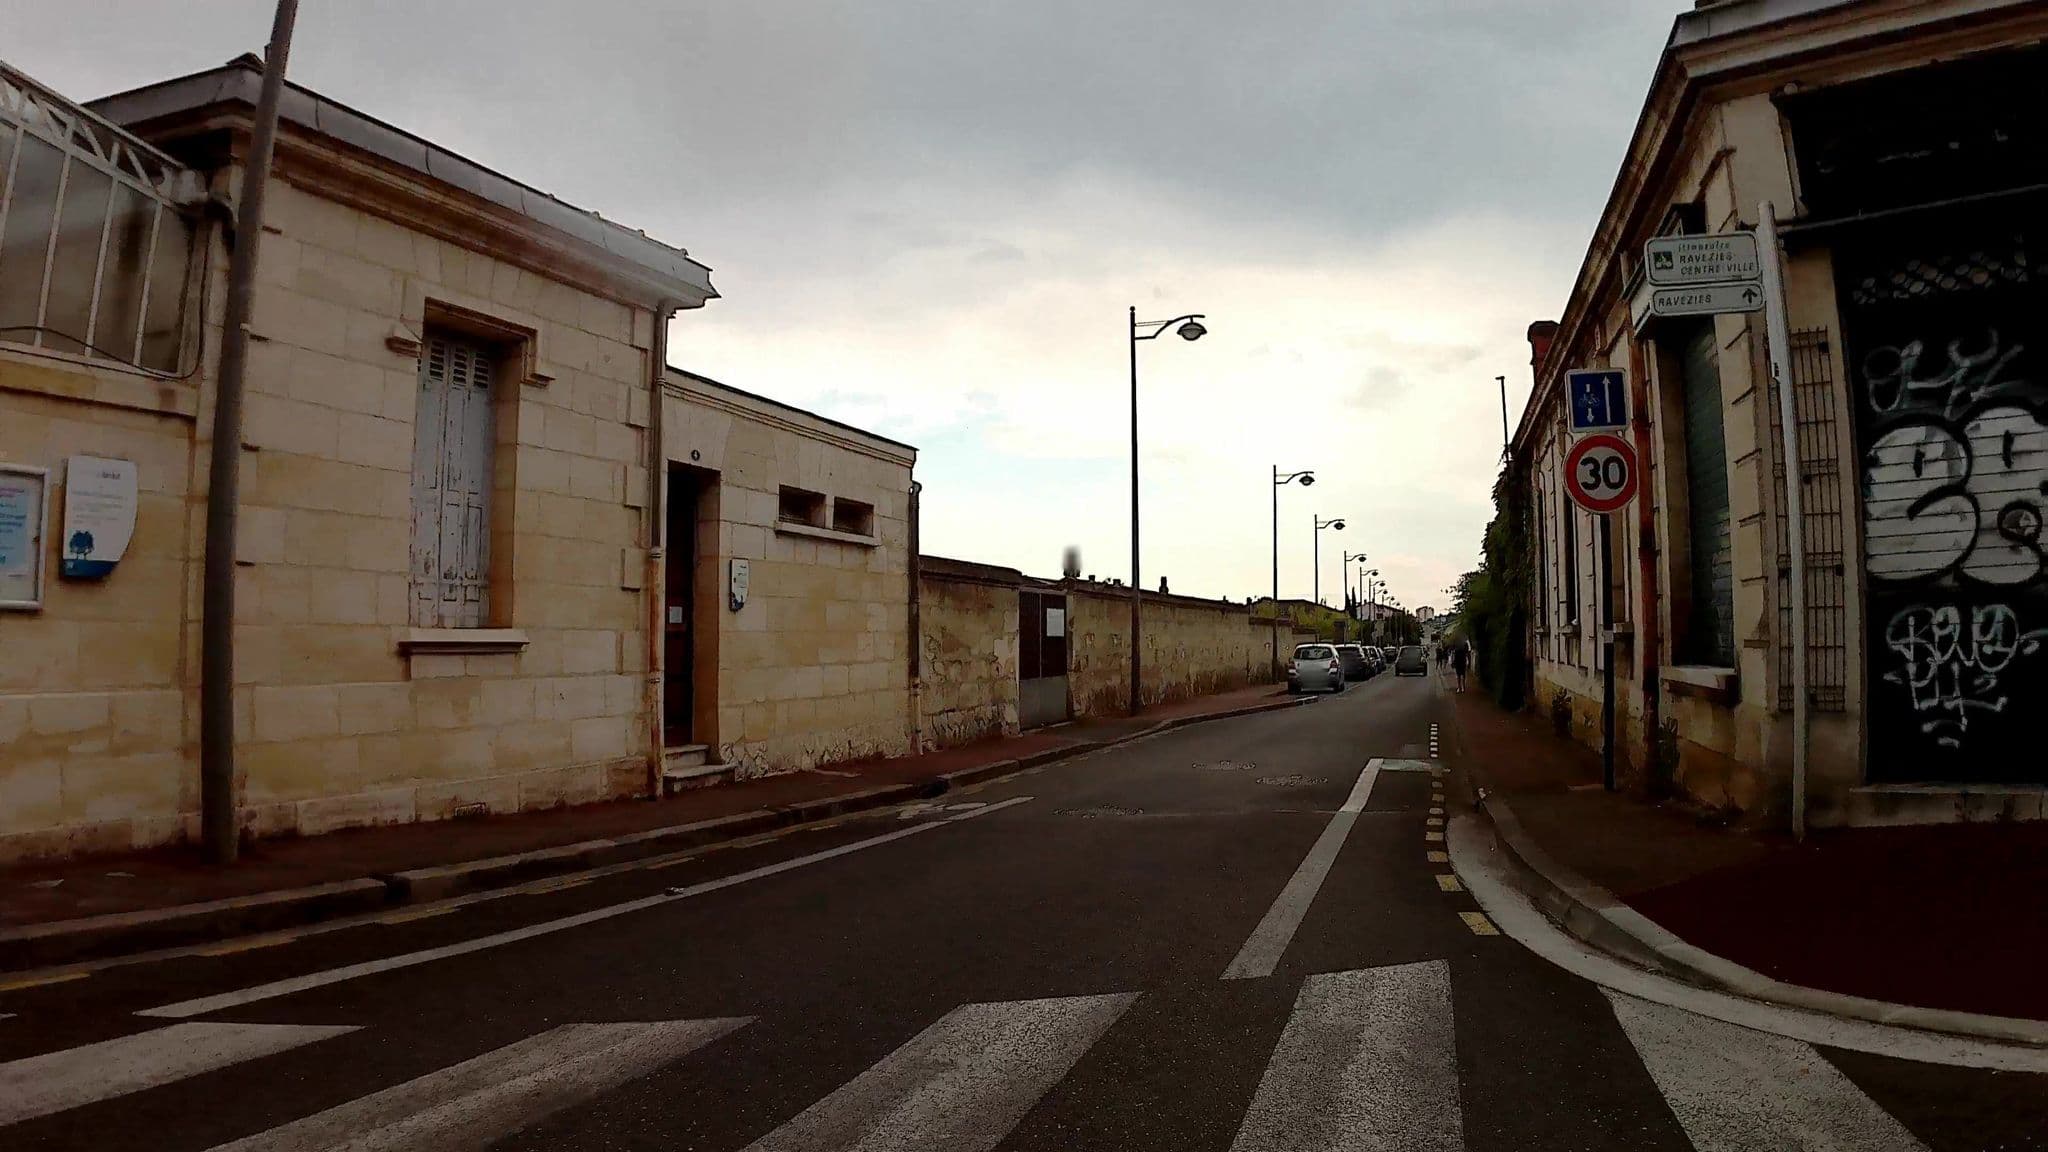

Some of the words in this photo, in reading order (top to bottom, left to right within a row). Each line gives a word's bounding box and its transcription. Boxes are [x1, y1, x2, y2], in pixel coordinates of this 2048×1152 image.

[1680, 251, 1733, 263] RAVEZIES
[1680, 264, 1720, 275] CENTRE
[1727, 261, 1754, 273] VILLE
[1658, 294, 1712, 307] RAVEZIES
[1580, 455, 1626, 490] 30
